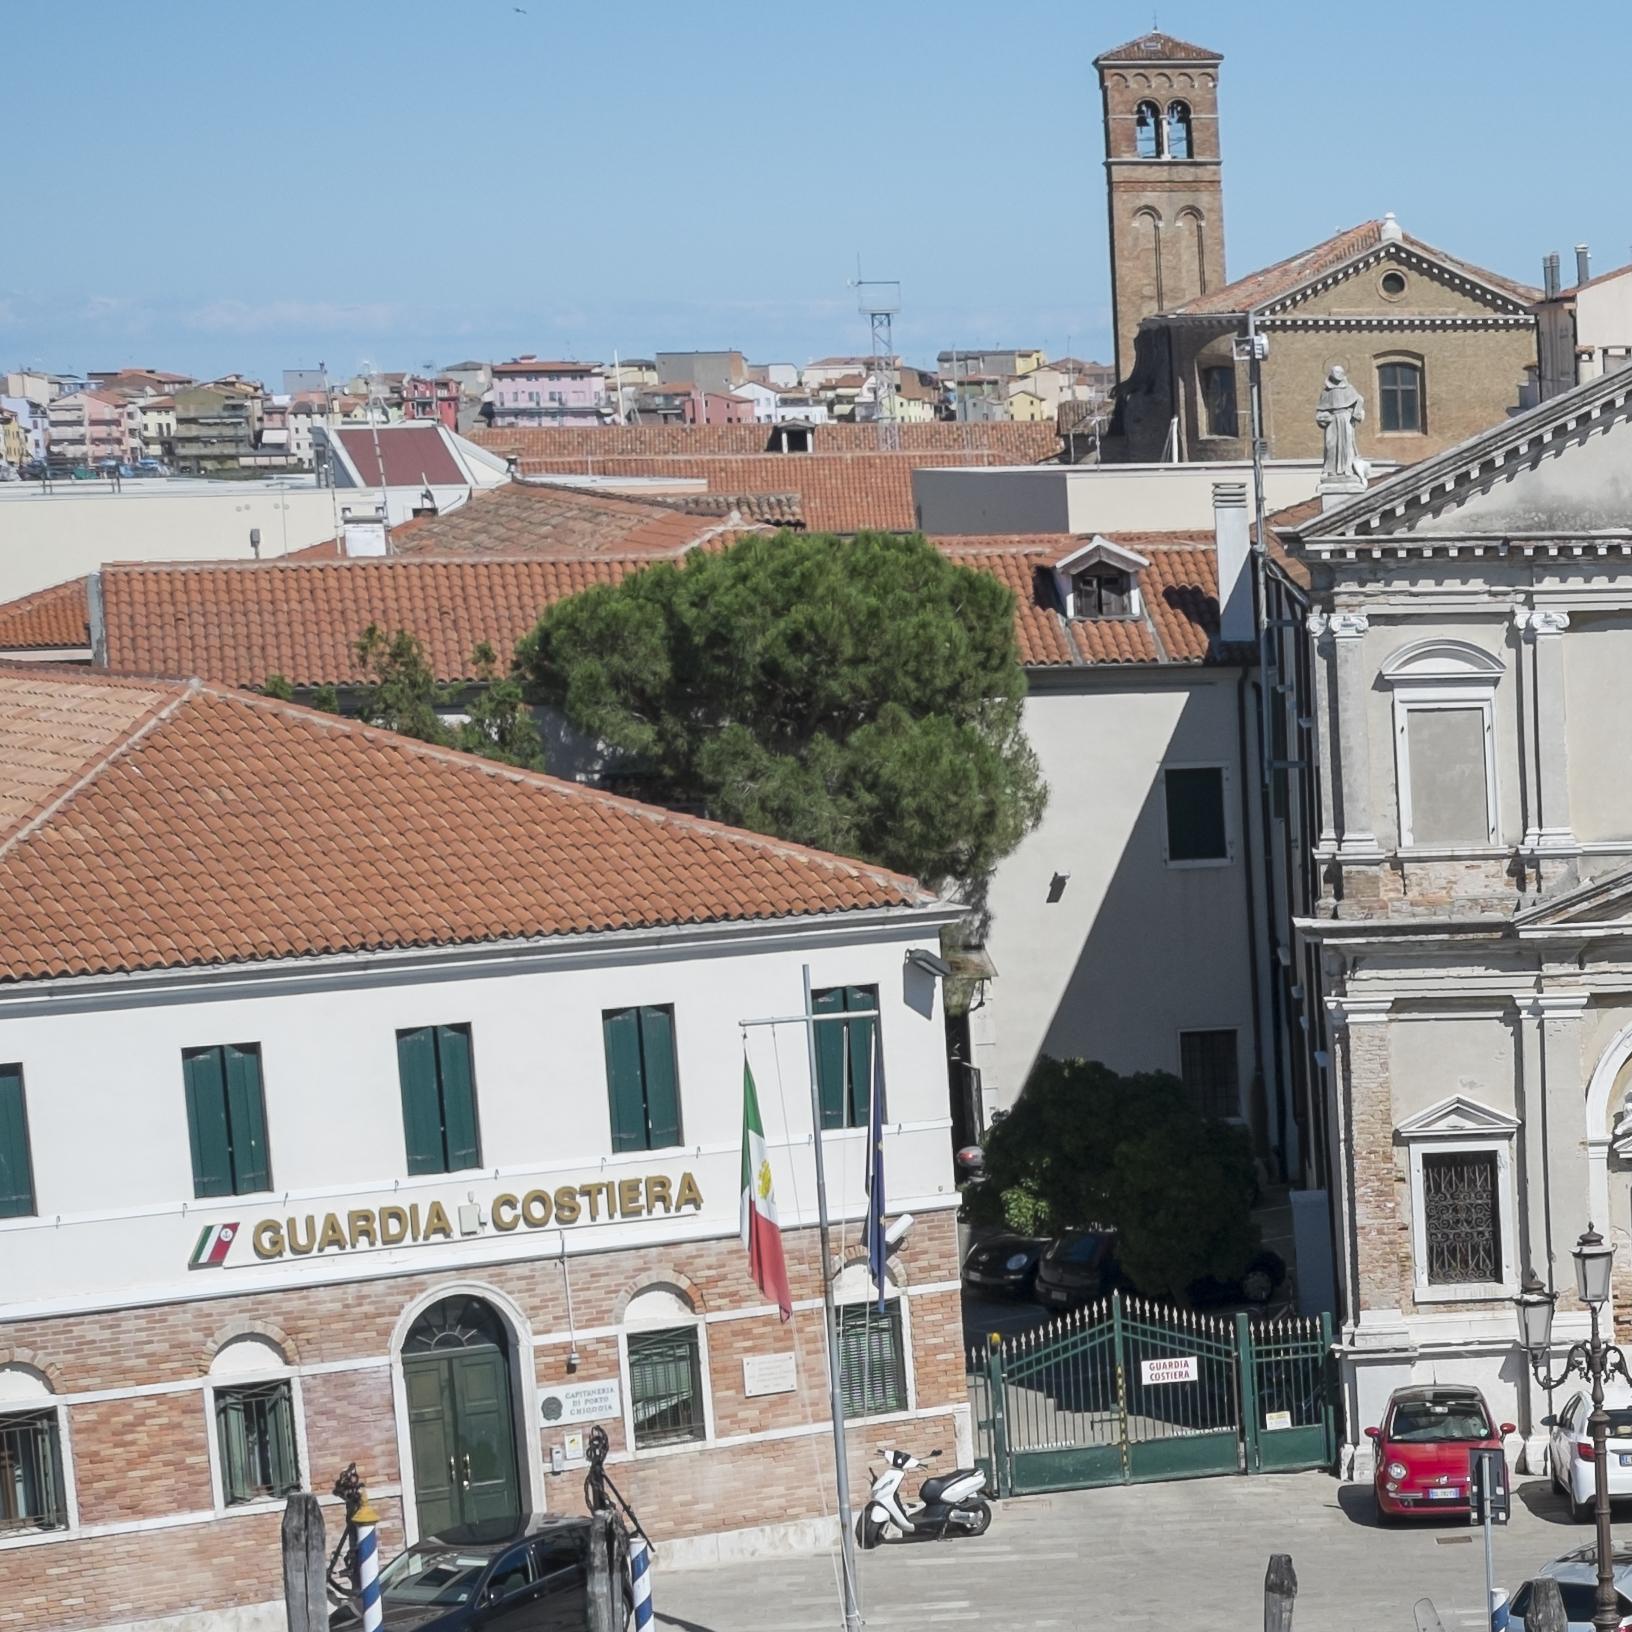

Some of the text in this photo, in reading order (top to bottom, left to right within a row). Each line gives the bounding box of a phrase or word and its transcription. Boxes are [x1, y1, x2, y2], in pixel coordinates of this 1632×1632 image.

[252, 1171, 704, 1260] GUARDIA COSTIERA
[1149, 1359, 1190, 1372] GUARDIA
[1149, 1370, 1190, 1382] COSTIERA
[565, 1387, 616, 1400] CAPITANERIA
[584, 1396, 609, 1406] PORTO
